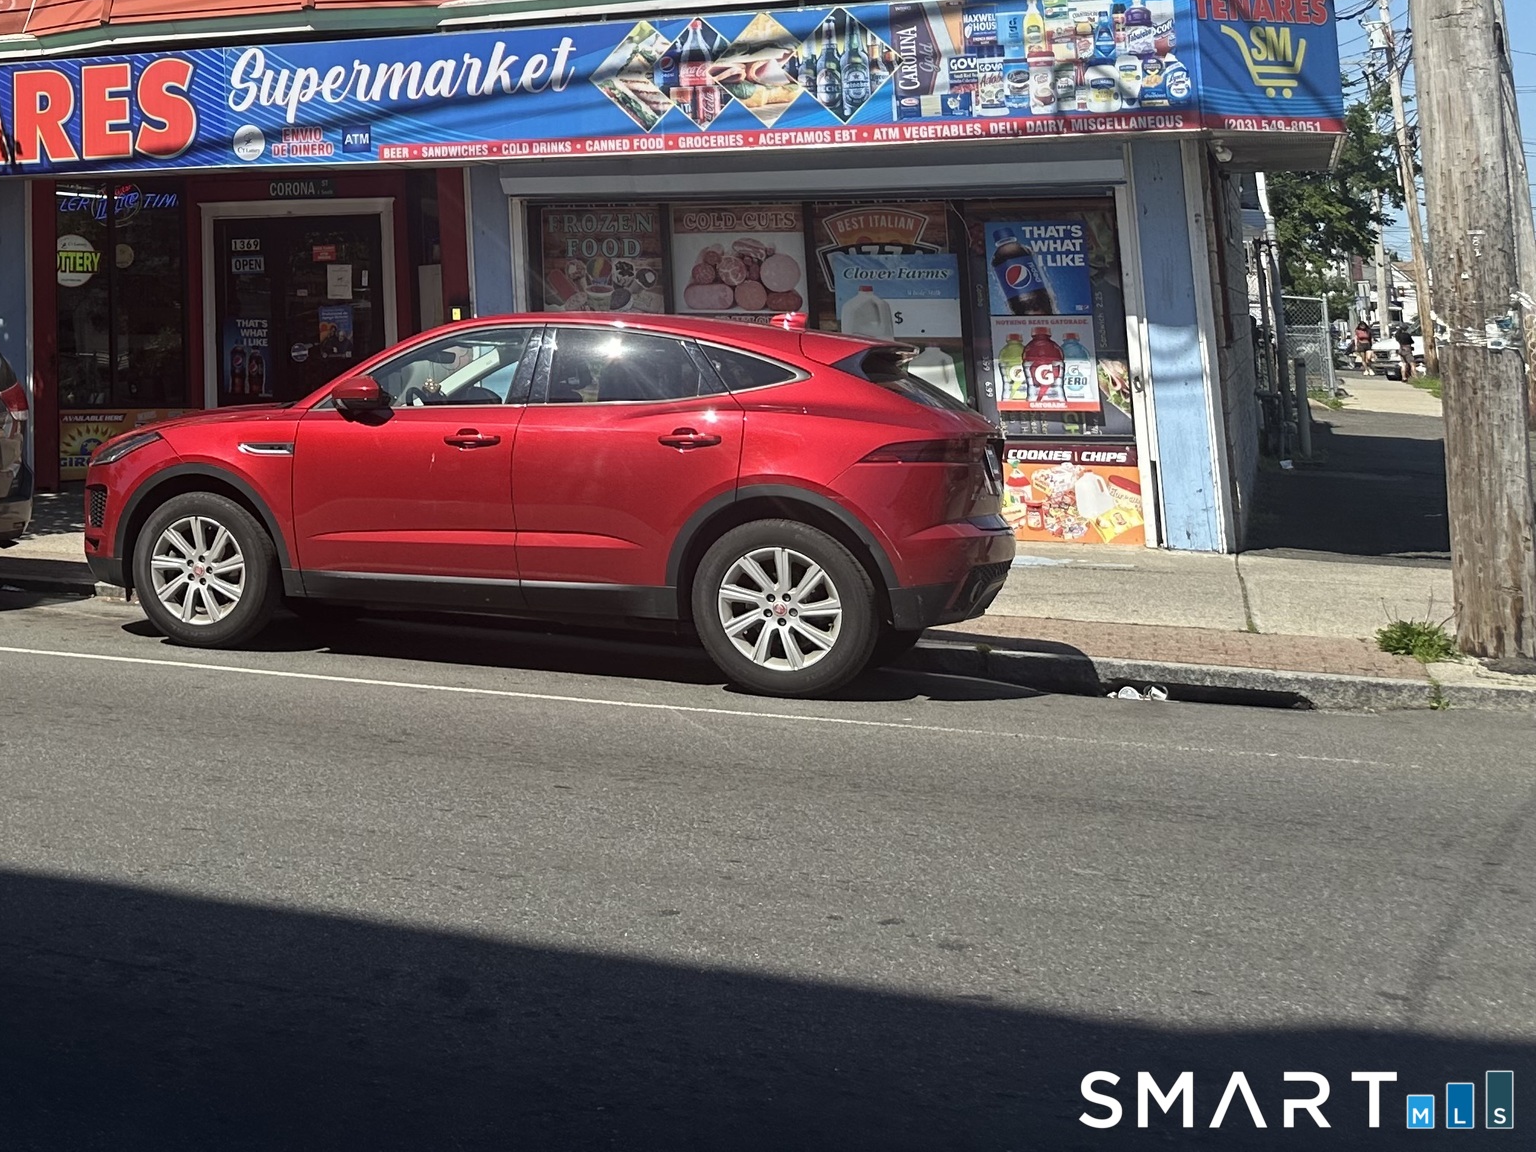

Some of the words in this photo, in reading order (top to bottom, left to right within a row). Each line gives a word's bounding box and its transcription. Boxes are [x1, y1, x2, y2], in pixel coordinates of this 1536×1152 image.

[1250, 26, 1292, 61] SM
[897, 26, 920, 90] CAROLINA
[228, 37, 577, 124] Supermarket
[1225, 119, 1257, 130] (203)
[282, 128, 323, 142] ENVIO
[344, 133, 369, 145] ATM
[383, 147, 409, 159] BEER
[421, 144, 488, 158] SANDWICHES
[501, 142, 529, 155] COLD
[533, 140, 572, 154] DRINKS
[585, 138, 631, 152] CANNED
[633, 137, 664, 150] FOOD
[678, 134, 744, 148] GROCERIES
[758, 130, 831, 145] ACEPTAMOS
[834, 129, 857, 142] EBT
[873, 127, 900, 140] ATM
[903, 123, 986, 139] VEGETABLES,
[990, 121, 1023, 136] DELI,
[1026, 119, 1068, 135] DAIRY,
[1071, 115, 1184, 131] MISCELLANEOUS
[272, 145, 287, 157] DE
[290, 143, 334, 156] DINERO
[270, 181, 315, 196] CORONA
[143, 192, 180, 209] TIM
[547, 212, 654, 234] FROZEN
[683, 212, 736, 230] COLD
[742, 211, 797, 229] CUTS
[836, 216, 865, 233] BEST
[869, 215, 914, 230] ITALIAN
[1022, 224, 1083, 239] THAT'S
[233, 240, 260, 251] 1369
[566, 237, 641, 258] FOOD
[1030, 239, 1083, 253] WHAT
[234, 258, 262, 272] OPEN
[1038, 255, 1044, 267] I
[1047, 254, 1085, 267] LIKE
[843, 267, 896, 281] Clover
[897, 267, 951, 281] Farms
[236, 319, 268, 328] THAT'S
[894, 311, 904, 325] $
[240, 329, 268, 338] WHAT
[248, 338, 268, 347] LIKE
[1035, 364, 1055, 385] G
[62, 415, 104, 423] AVAILABLE
[105, 414, 125, 422] HERE
[1007, 449, 1072, 461] COOKIES
[1081, 451, 1127, 463] CHIPS
